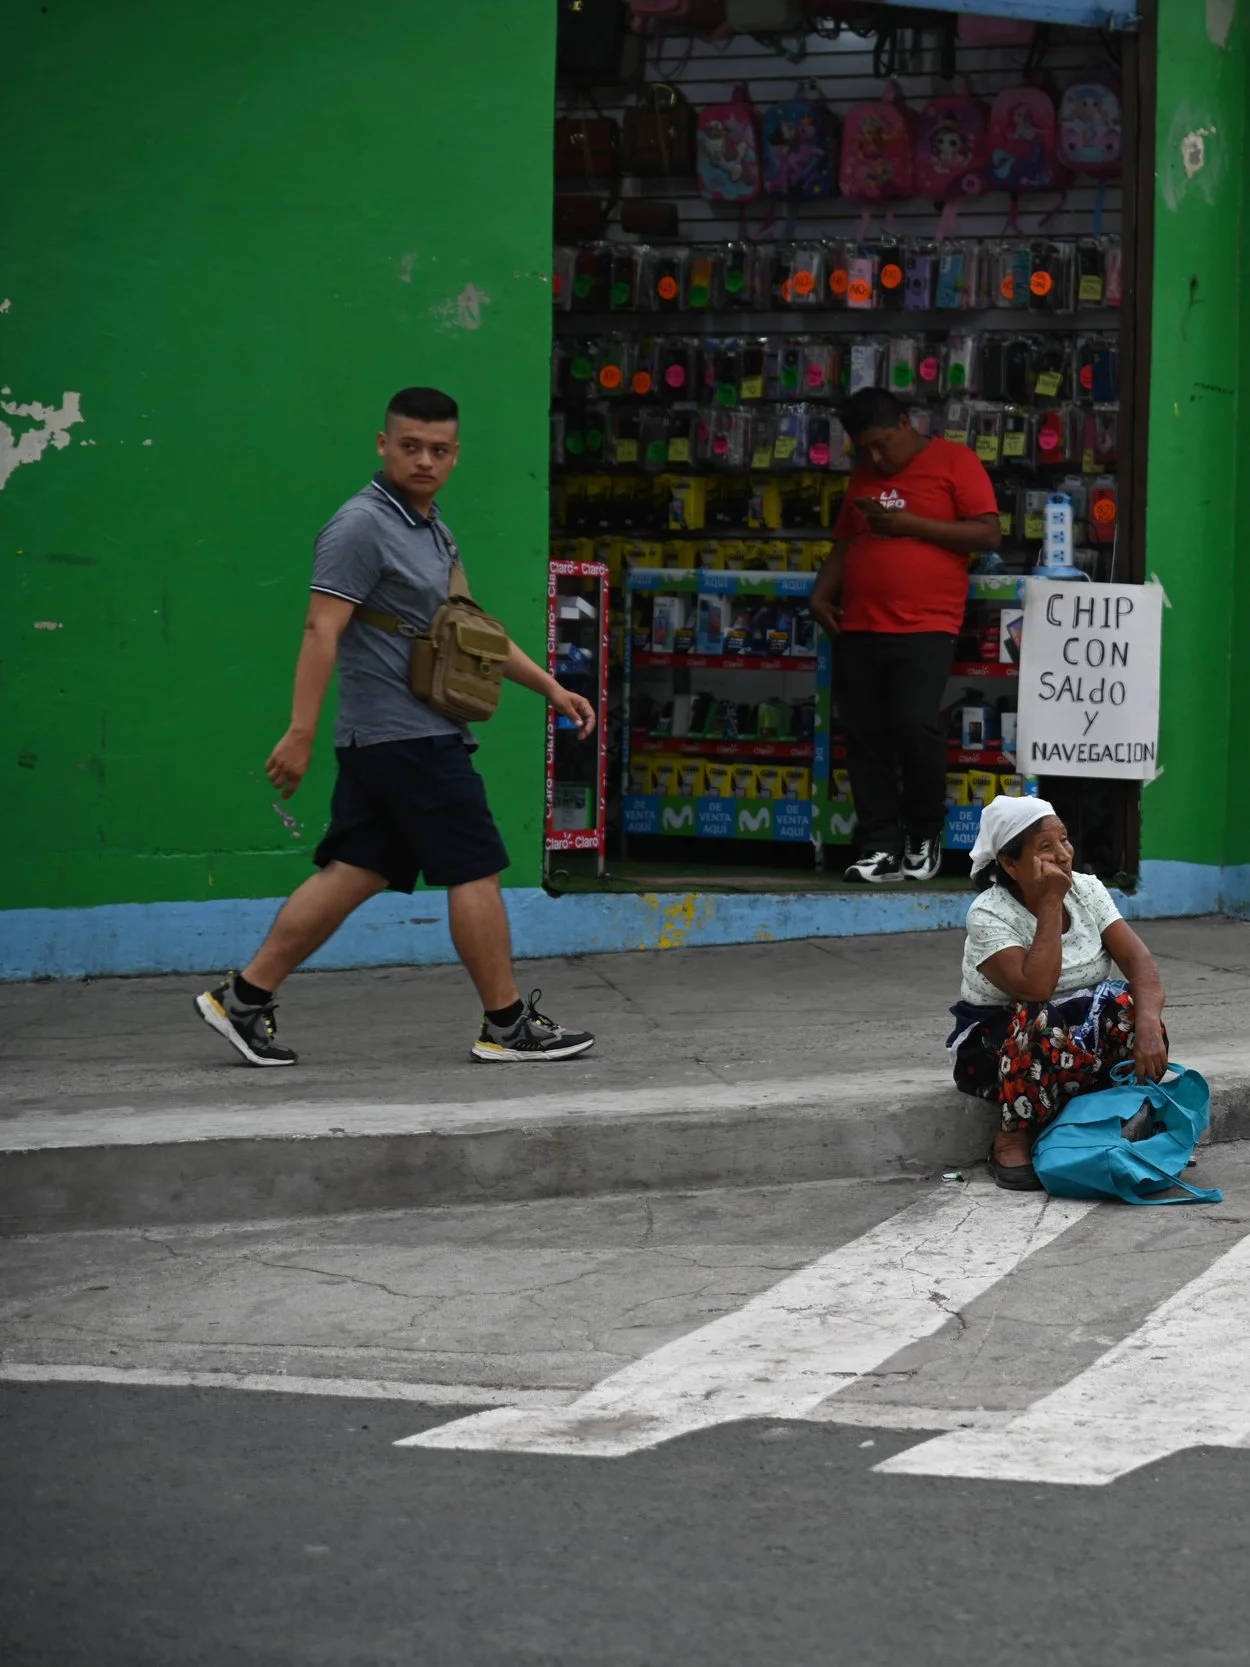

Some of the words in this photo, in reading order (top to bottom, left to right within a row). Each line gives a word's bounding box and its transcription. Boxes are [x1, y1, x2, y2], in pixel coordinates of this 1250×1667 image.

[880, 489, 898, 499] LA
[549, 561, 574, 574] Claro
[581, 563, 605, 576] Claro
[548, 574, 556, 597] Cla
[1046, 593, 1134, 630] CHIP
[547, 612, 556, 653] Claro
[1063, 637, 1129, 668] CON
[1006, 668, 1019, 676] Cla
[546, 723, 555, 764] Claro
[1031, 741, 1155, 764] NAVEGACION
[709, 802, 722, 812] DE
[786, 804, 799, 814] DE
[700, 812, 732, 822] VENTA
[776, 815, 808, 825] VENTA
[959, 811, 973, 820] DE
[780, 825, 804, 837] AQUÍ
[949, 821, 980, 831] VENTA
[545, 838, 569, 851] Claro
[575, 836, 599, 848] Claro
